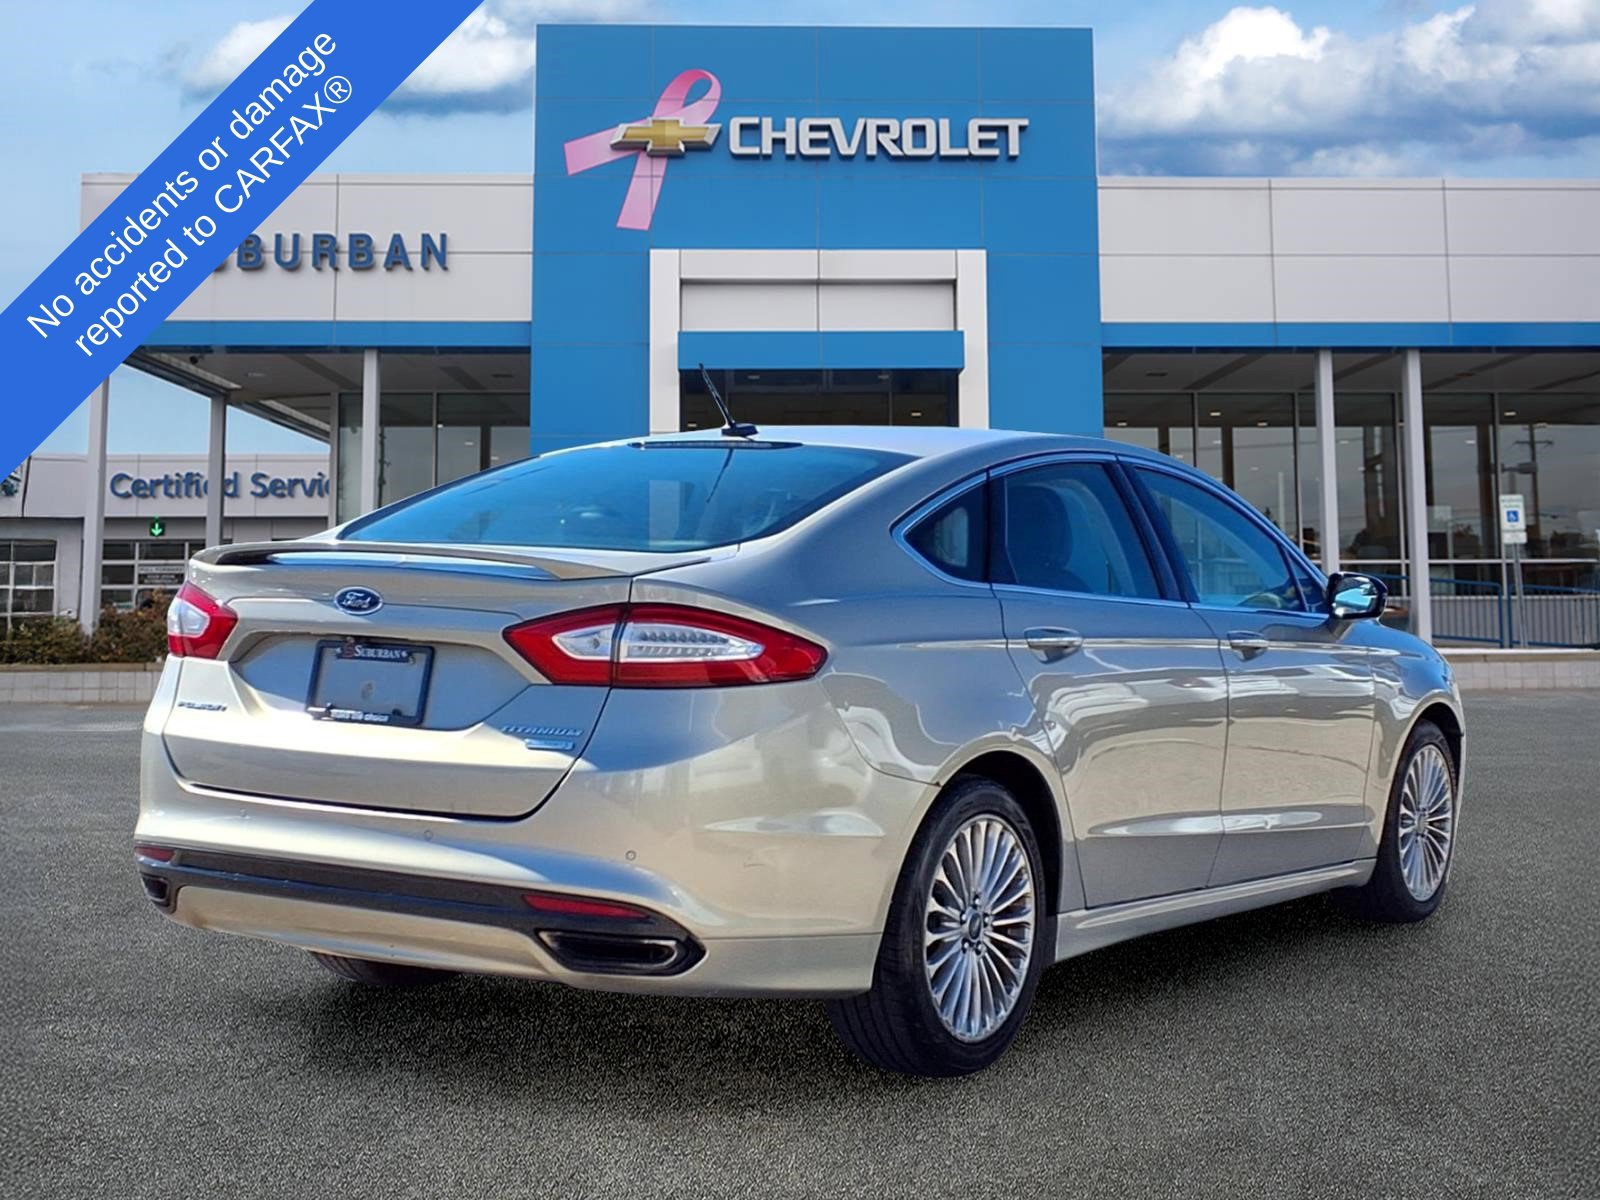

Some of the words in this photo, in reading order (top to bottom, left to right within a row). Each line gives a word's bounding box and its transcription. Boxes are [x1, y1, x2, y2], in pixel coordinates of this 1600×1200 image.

[728, 116, 1030, 158] CHEVROLET
[342, 591, 371, 609] Ford
[501, 725, 584, 737] TITANIUM
